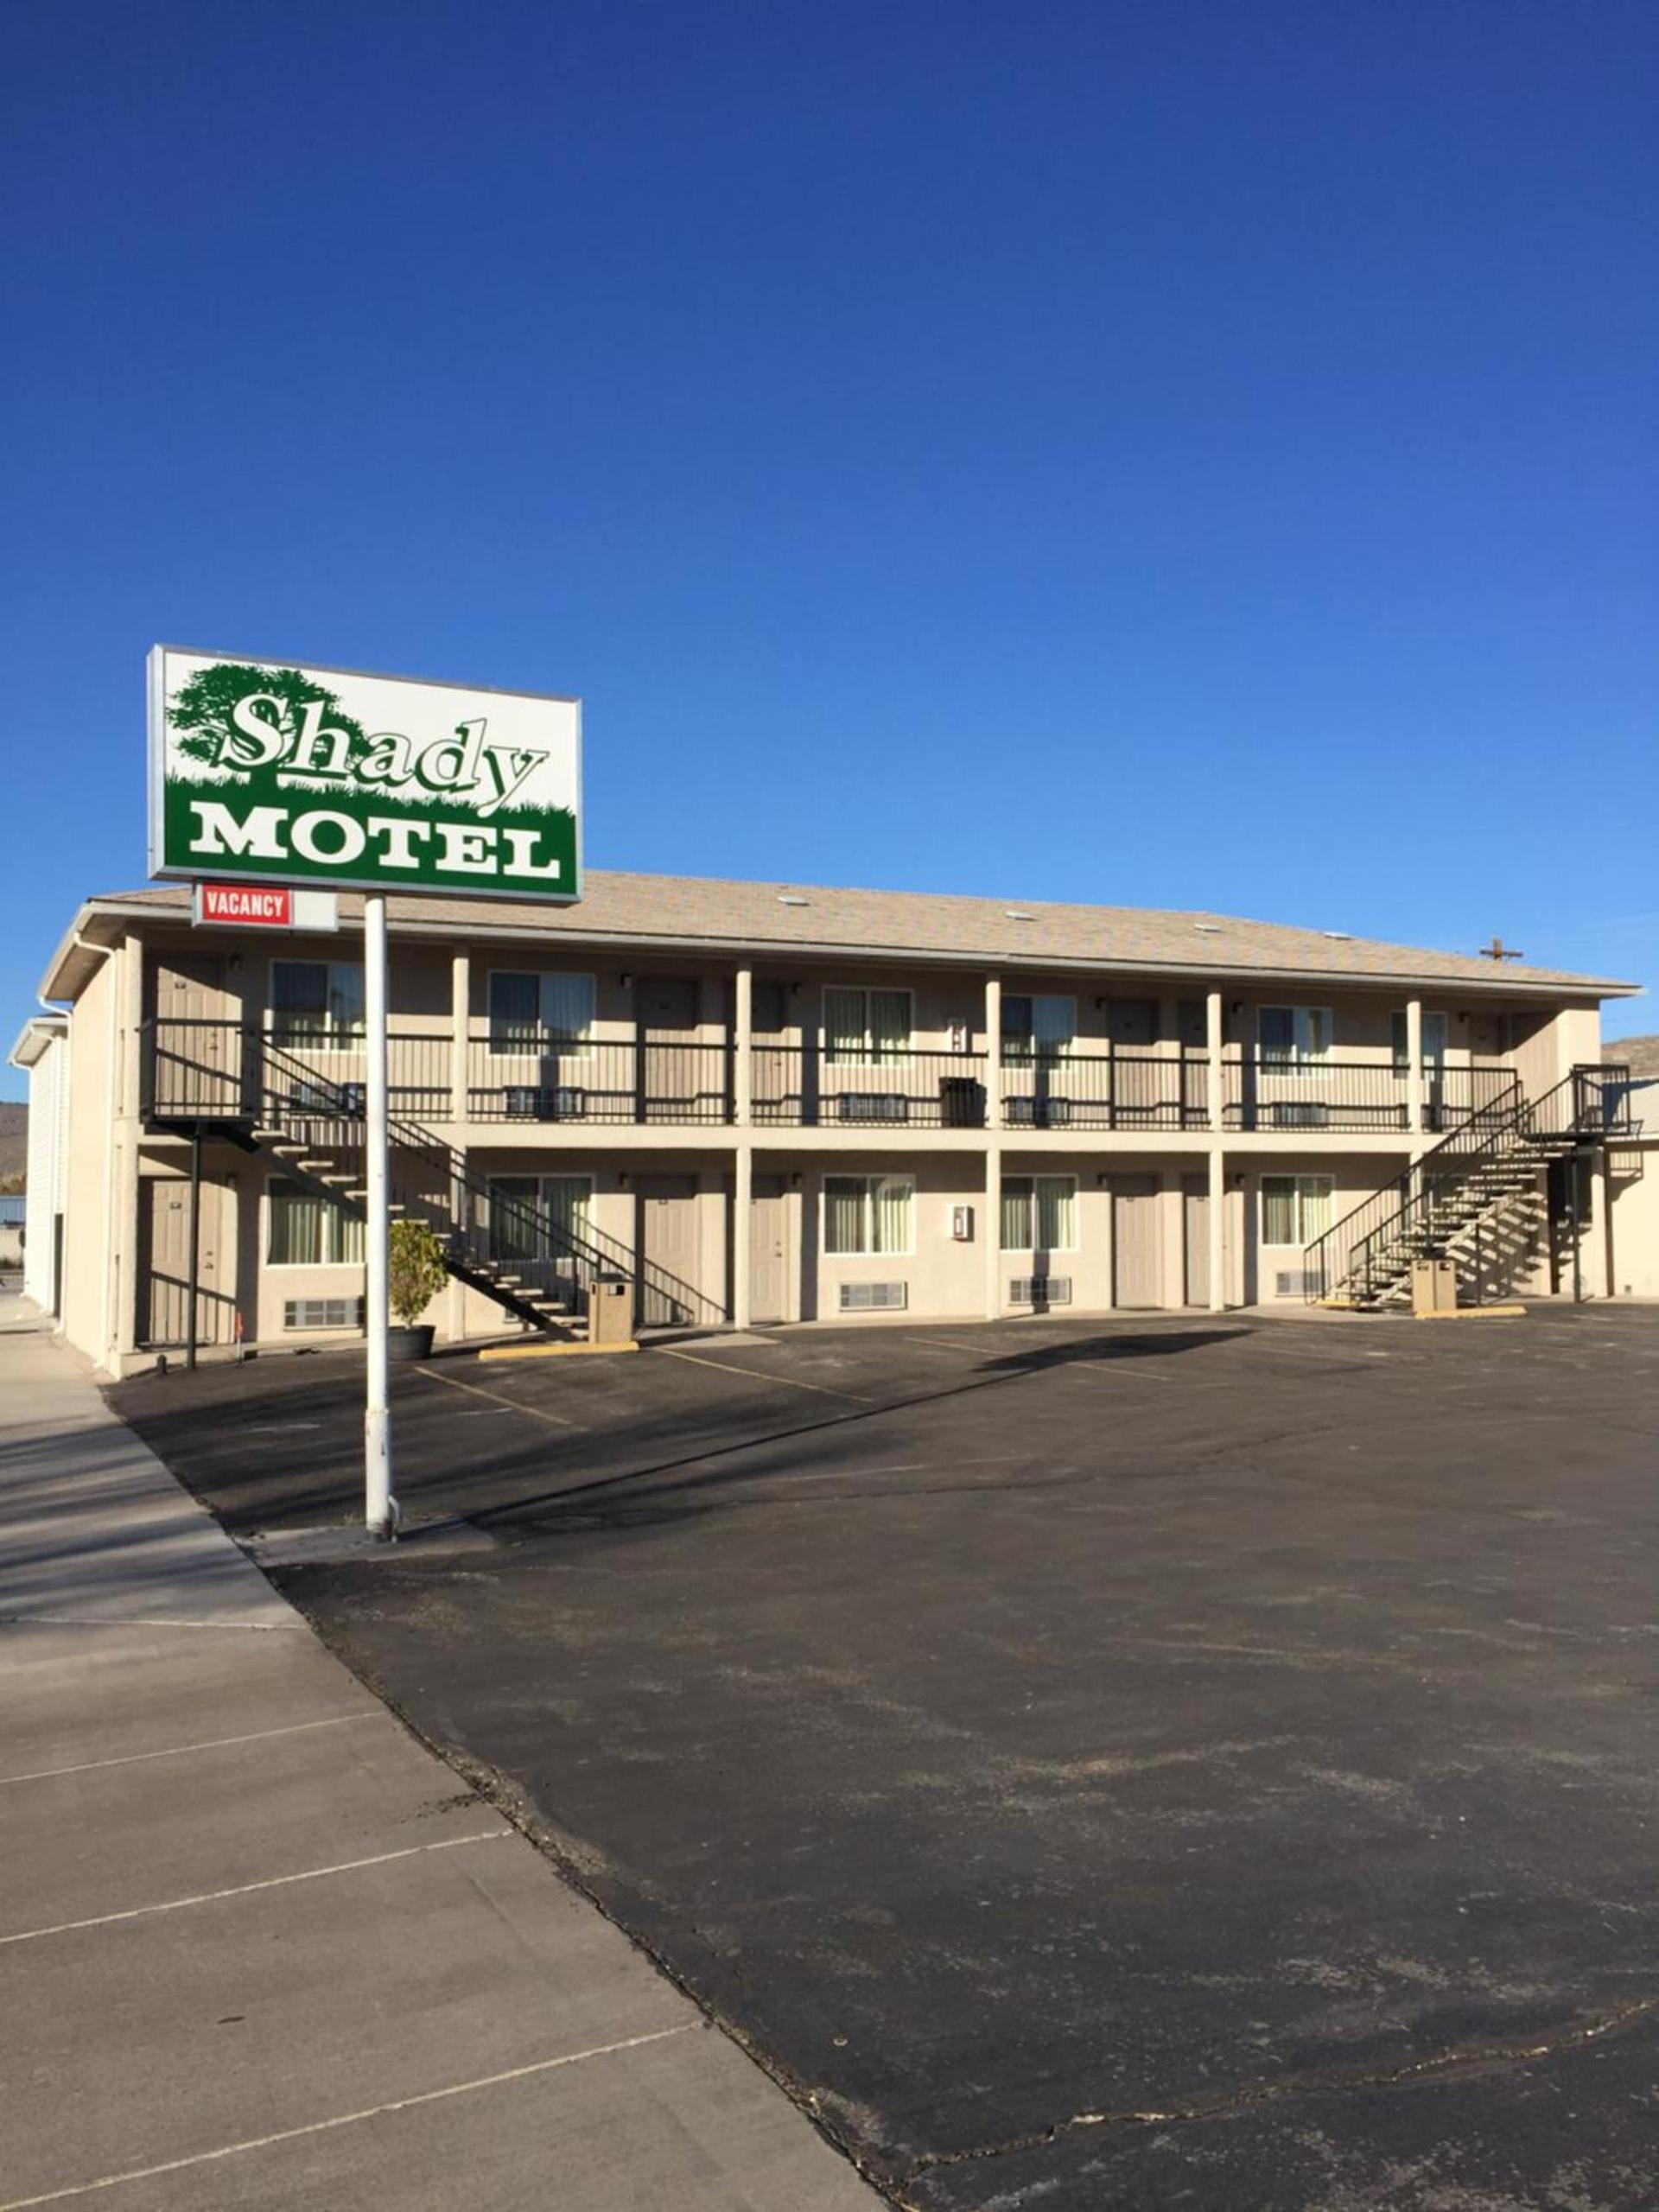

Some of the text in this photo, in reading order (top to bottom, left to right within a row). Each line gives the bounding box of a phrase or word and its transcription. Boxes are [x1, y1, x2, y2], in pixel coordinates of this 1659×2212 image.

[215, 693, 550, 818] Shady
[189, 800, 561, 879] MOTEL
[207, 891, 284, 918] VACANCY
